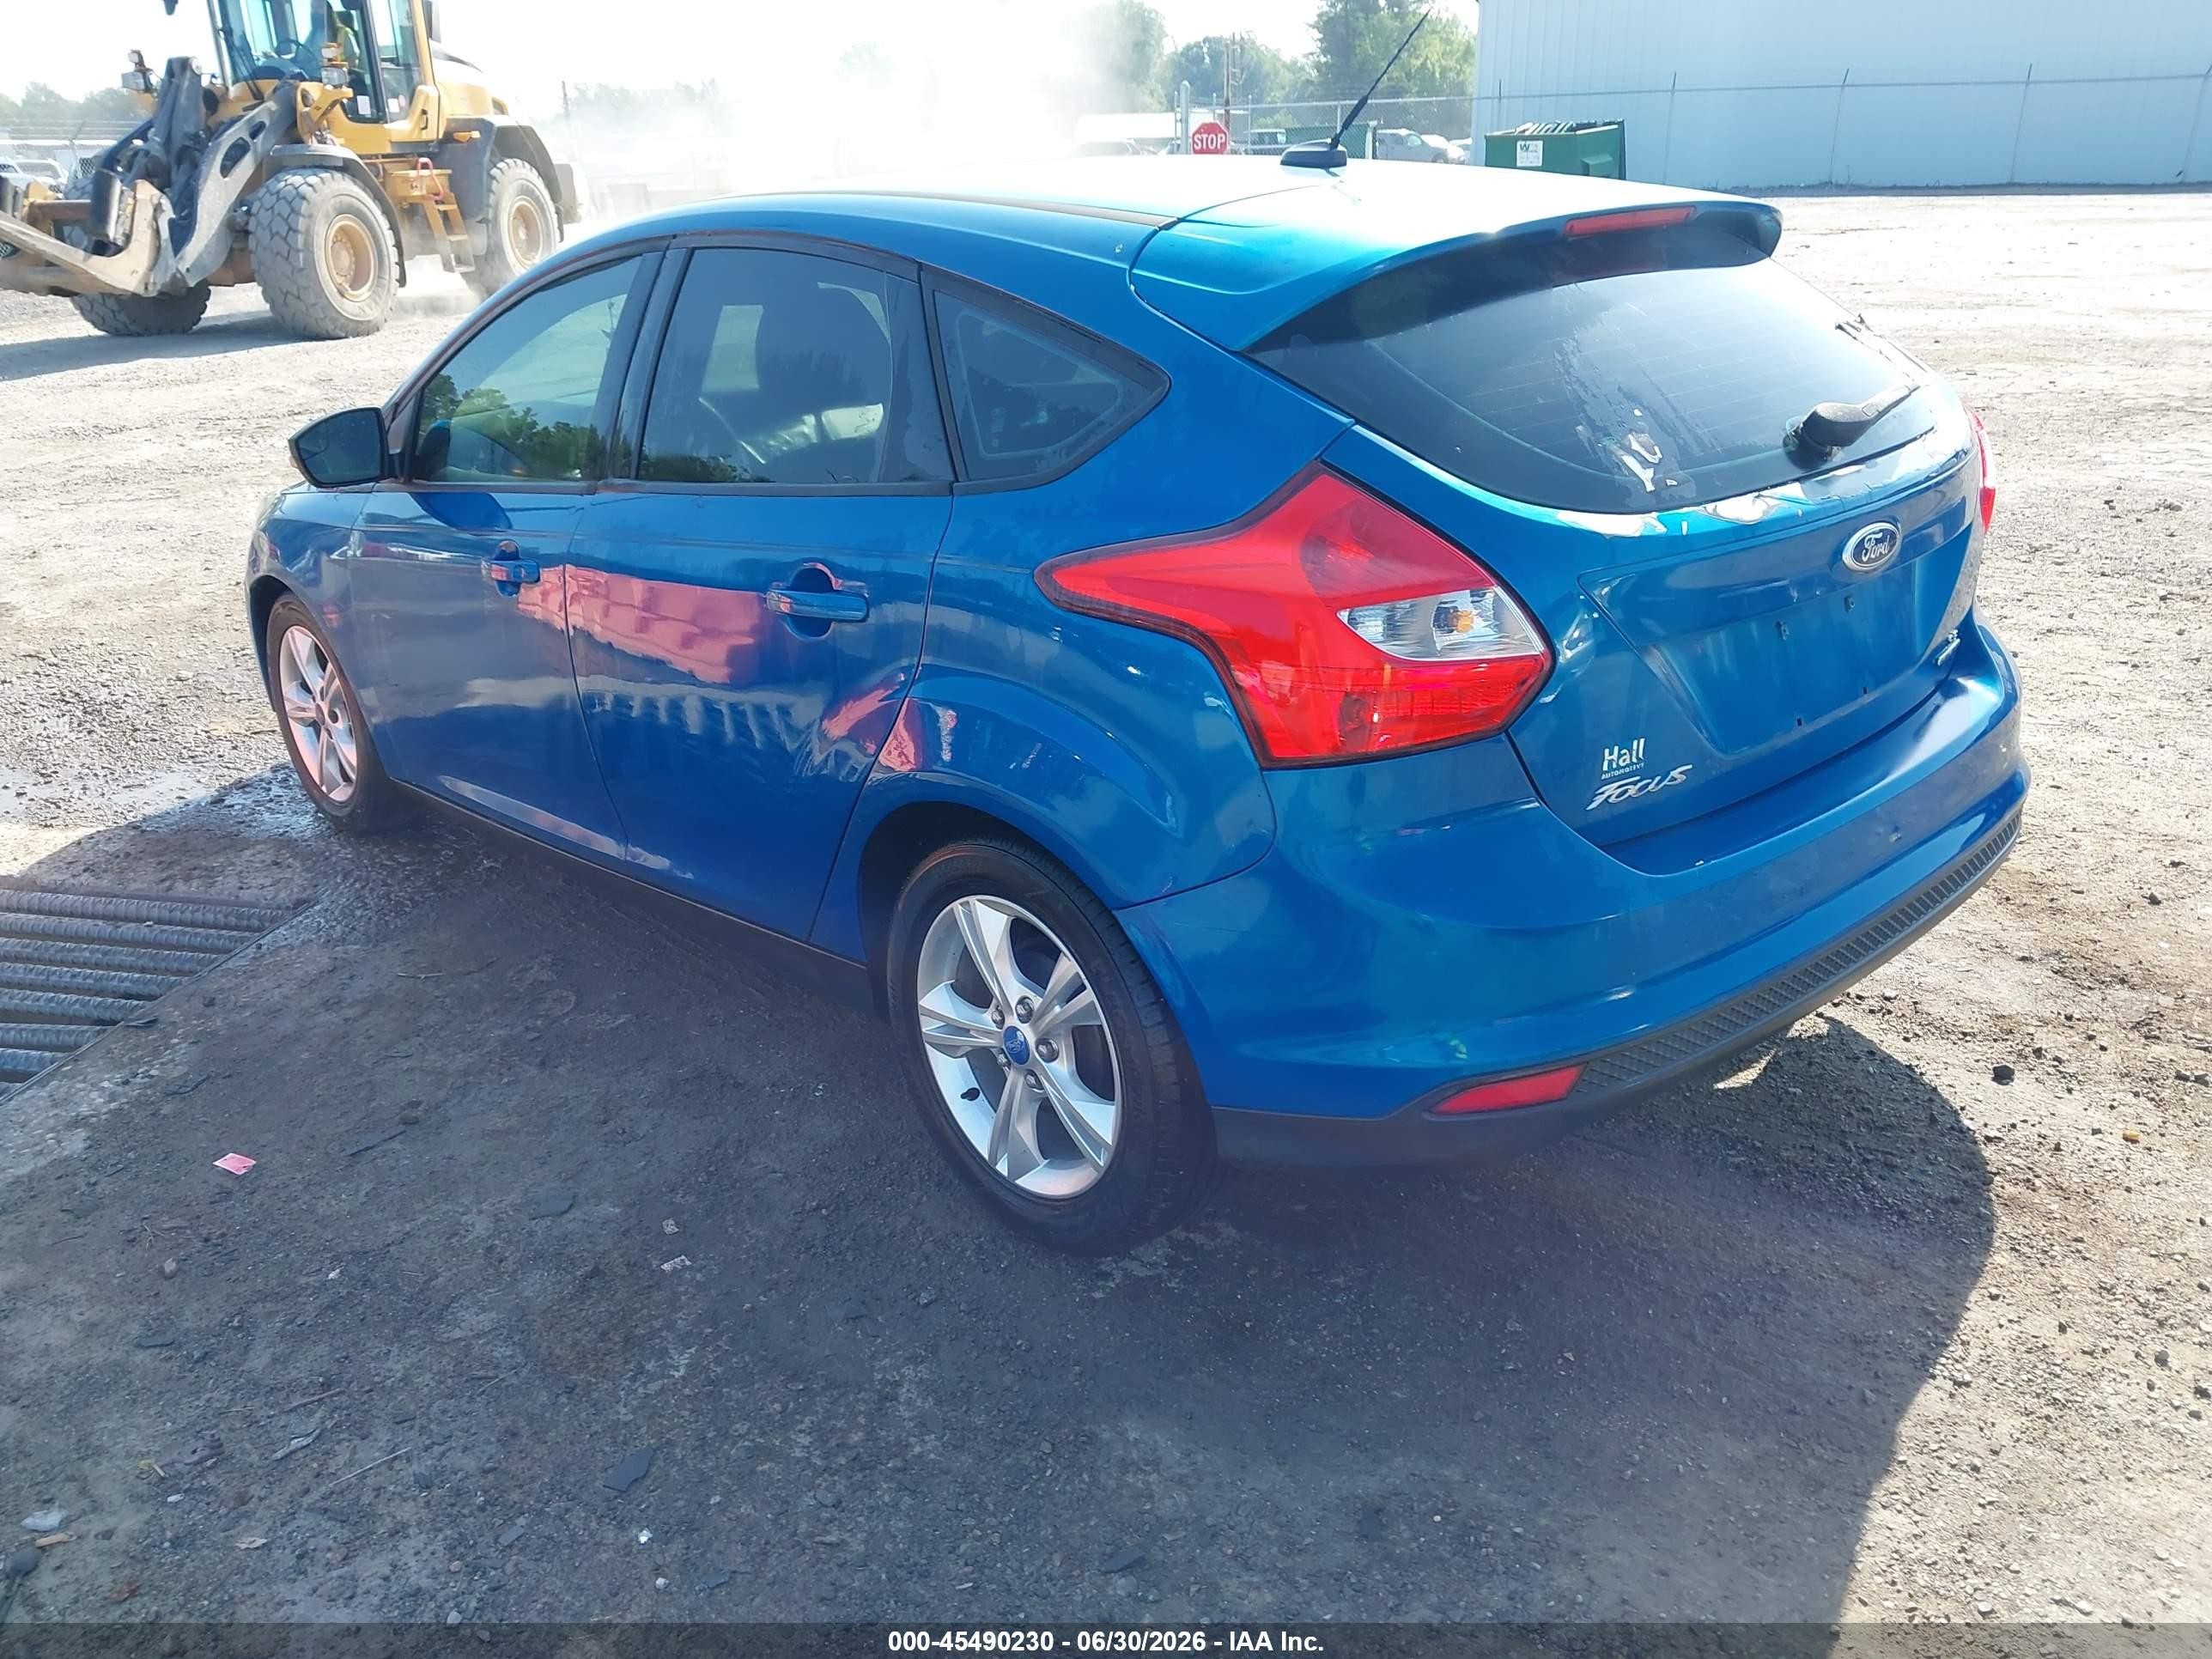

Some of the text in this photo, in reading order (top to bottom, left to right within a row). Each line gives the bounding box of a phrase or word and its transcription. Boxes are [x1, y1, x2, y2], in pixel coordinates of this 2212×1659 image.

[1194, 133, 1225, 149] STOP
[1862, 532, 1890, 562] Ford
[1602, 738, 1646, 771] Hall
